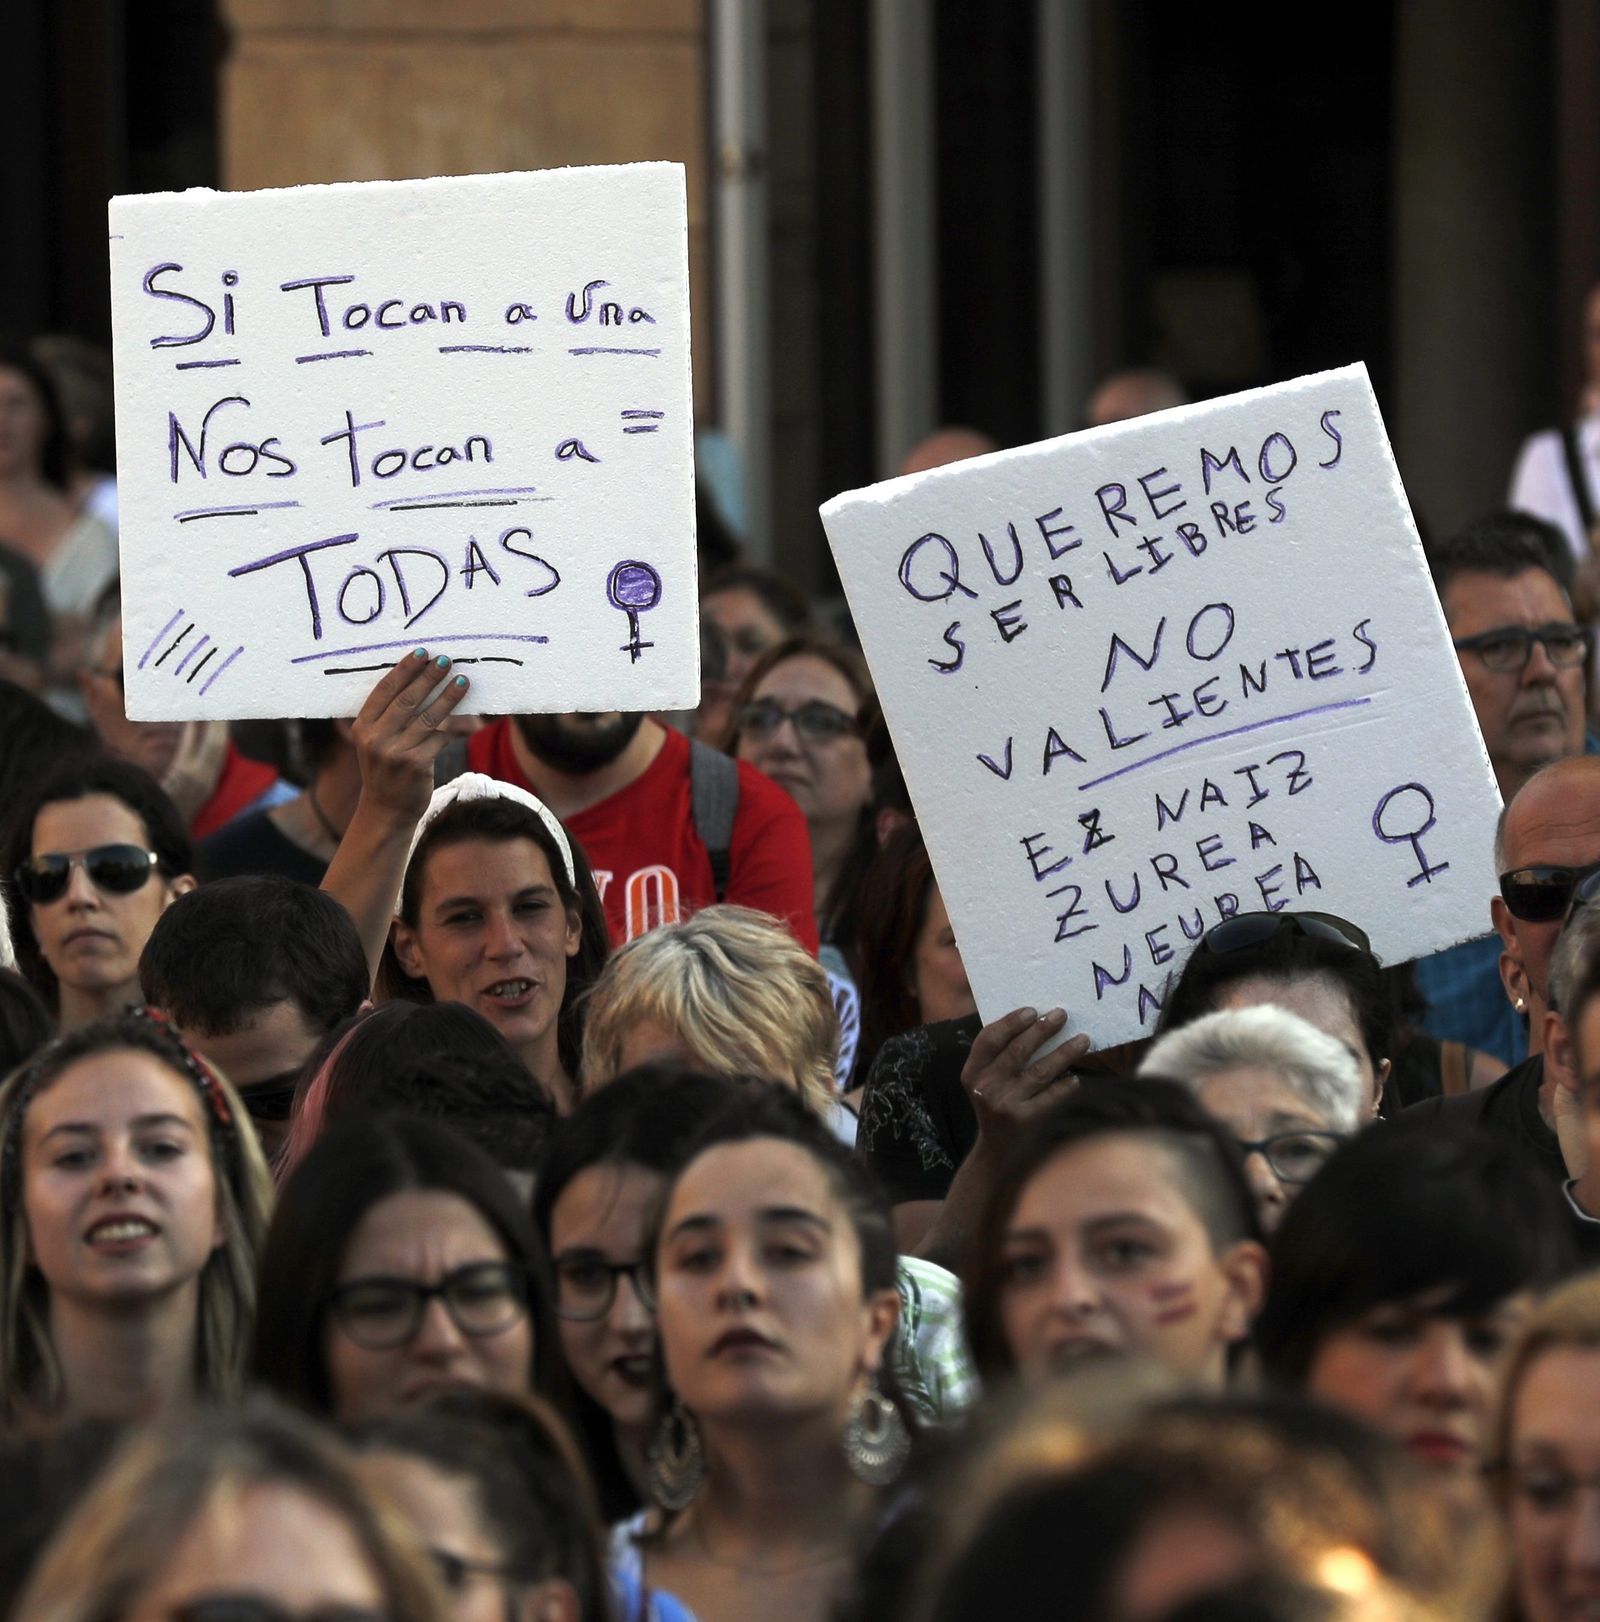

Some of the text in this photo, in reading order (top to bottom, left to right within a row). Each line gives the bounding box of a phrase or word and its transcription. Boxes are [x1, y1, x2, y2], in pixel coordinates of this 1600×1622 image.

[142, 261, 240, 350] Si
[279, 274, 467, 338] Tocan
[504, 302, 538, 326] a
[167, 395, 298, 485] Nos
[554, 437, 602, 464] a
[897, 409, 1343, 602] QUEREMOS
[226, 526, 562, 641] TODAS
[927, 486, 1287, 675] SER LIBRES
[975, 618, 1378, 781] VALIENTES
[1100, 601, 1236, 694] NO
[1019, 749, 1314, 883] EZ NAIZ
[1045, 820, 1278, 942] ZUREA
[1091, 851, 1322, 998] NEUREA
